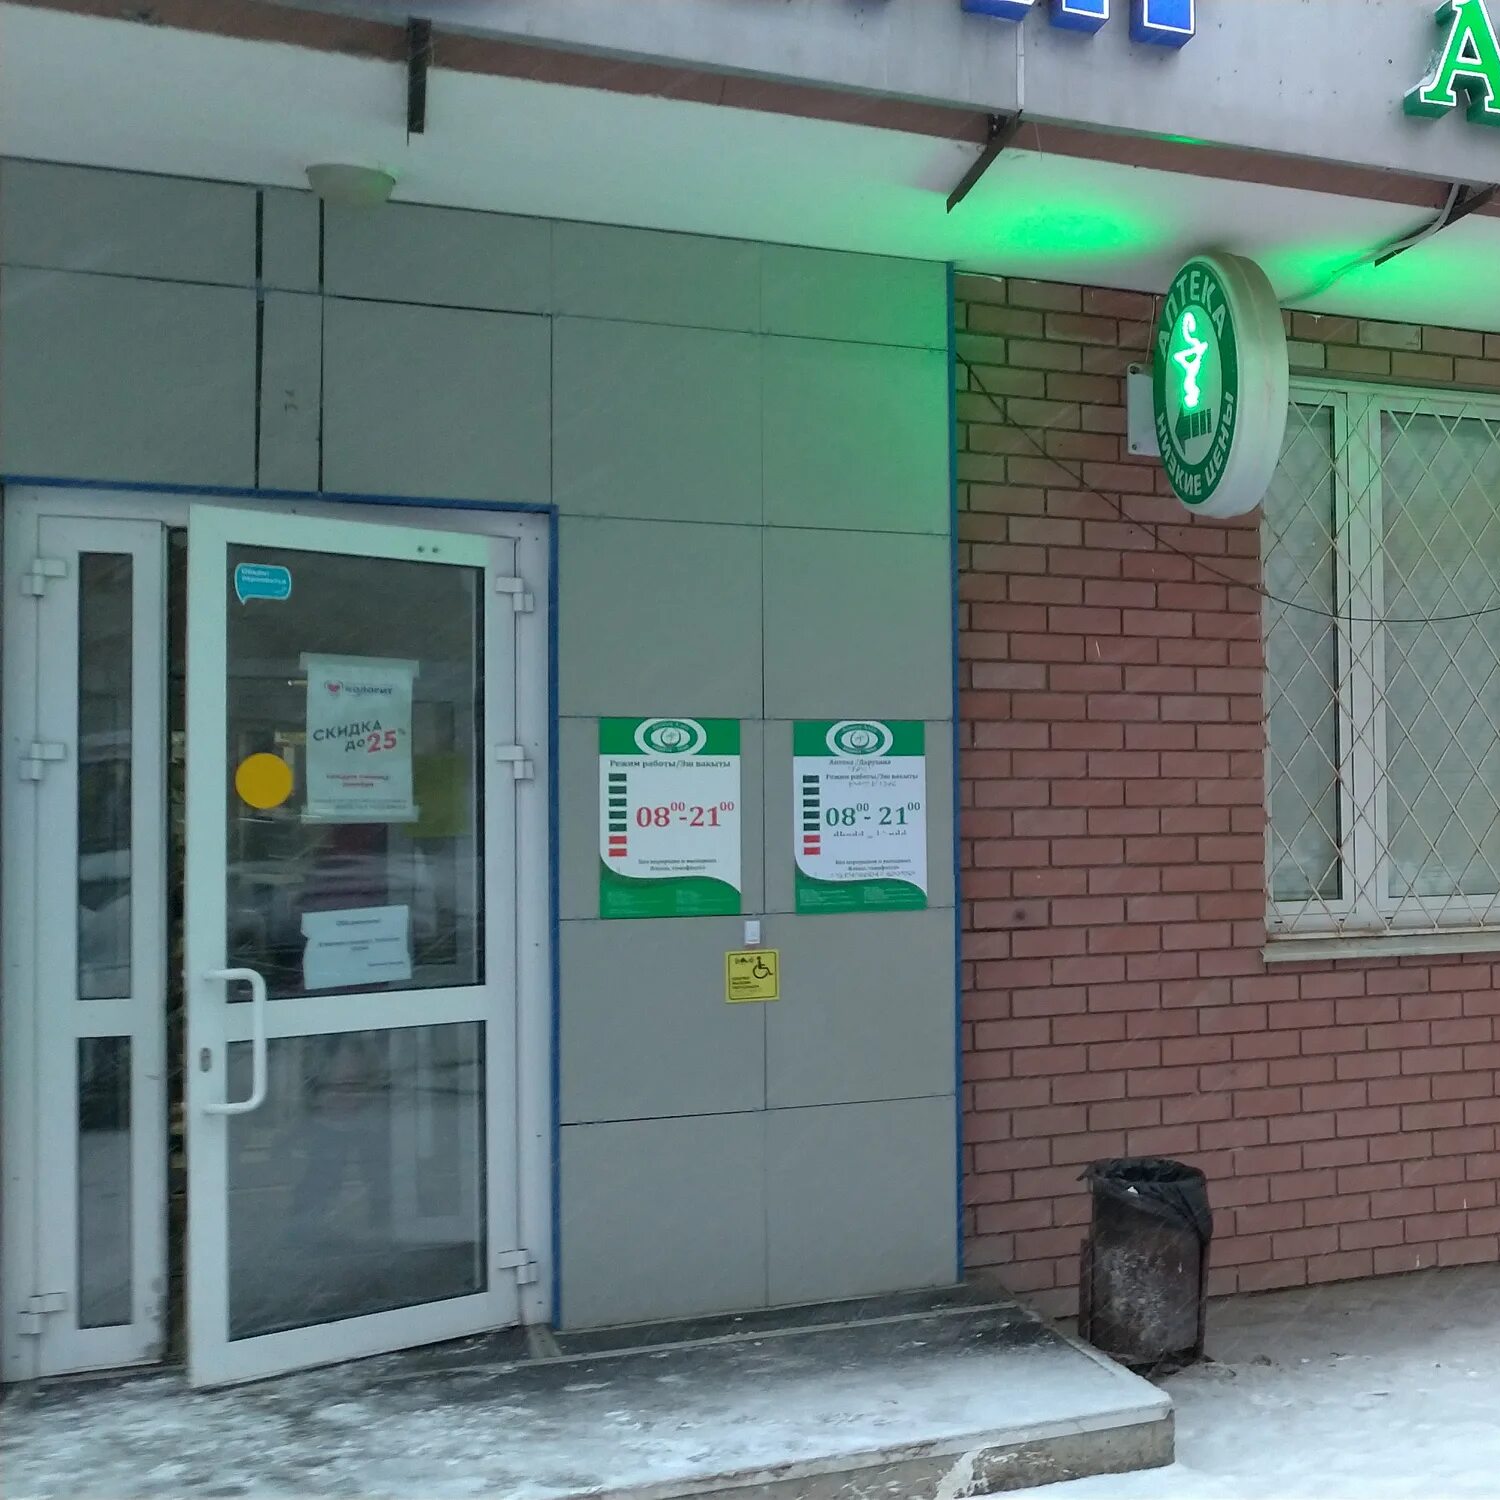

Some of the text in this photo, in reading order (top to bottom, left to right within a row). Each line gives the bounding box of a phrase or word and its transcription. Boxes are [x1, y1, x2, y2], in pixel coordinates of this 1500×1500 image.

[1158, 270, 1227, 362] АПТЕКА
[1156, 390, 1235, 496] НИЗКИЕ ЦЕНЫ
[312, 719, 382, 742] СКИДКА
